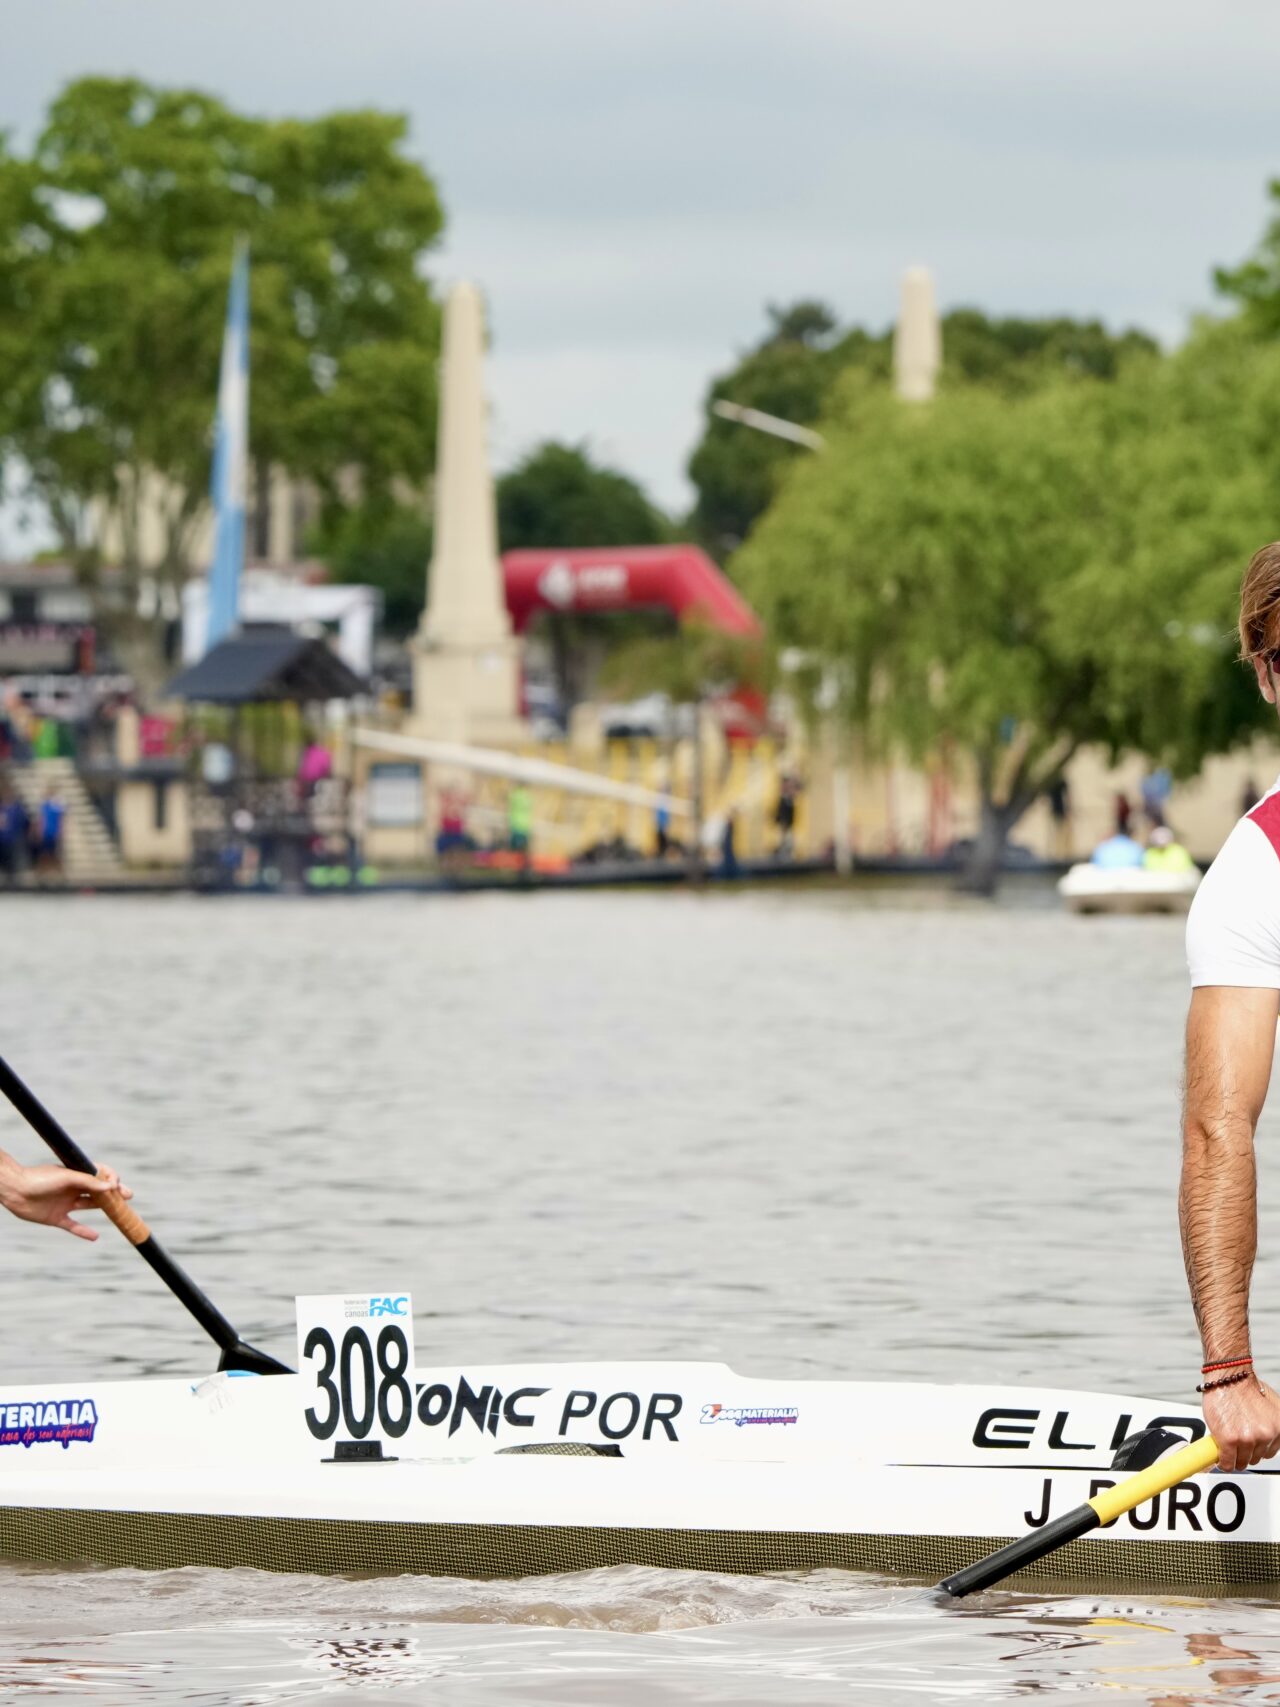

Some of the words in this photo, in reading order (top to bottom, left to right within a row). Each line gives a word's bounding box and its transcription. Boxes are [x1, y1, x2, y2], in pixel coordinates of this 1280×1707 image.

[369, 1297, 408, 1317] FAC
[303, 1324, 413, 1441] 308
[416, 1374, 553, 1439] ONIC
[558, 1391, 684, 1442] POR
[742, 1408, 799, 1418] MATERIALIA
[1024, 1478, 1053, 1528] J
